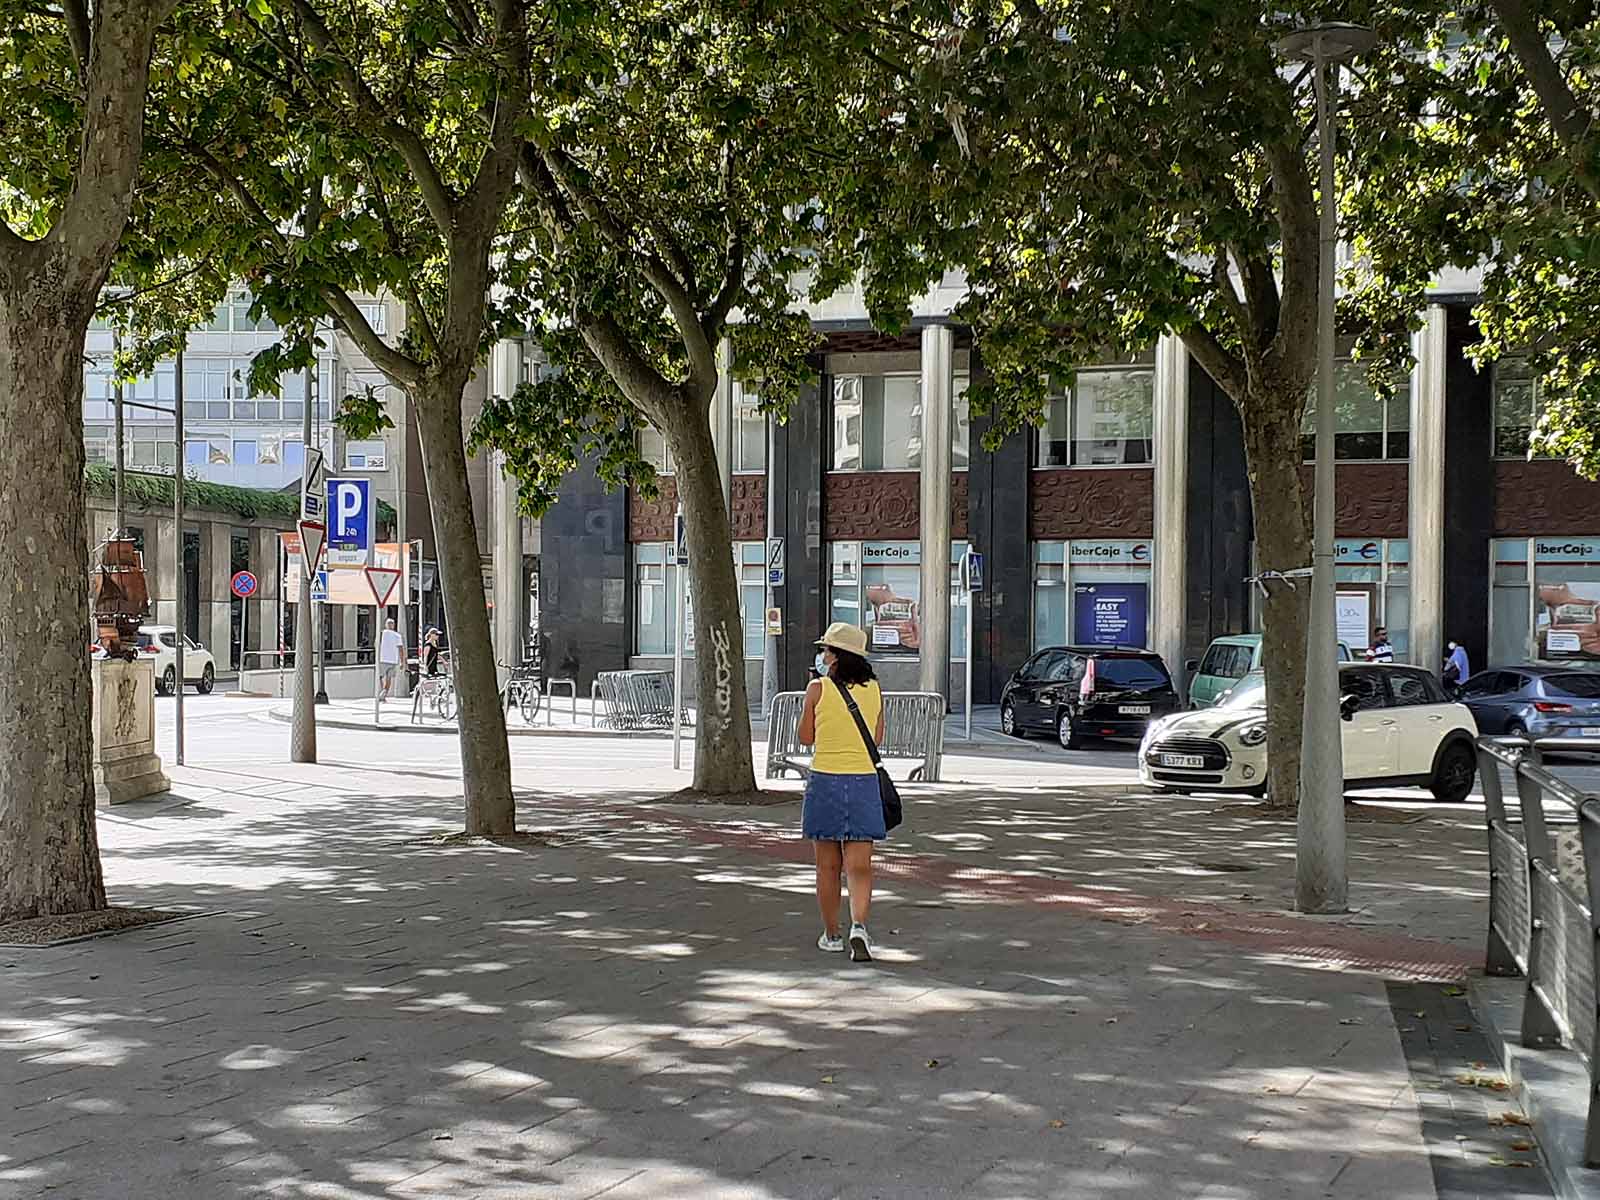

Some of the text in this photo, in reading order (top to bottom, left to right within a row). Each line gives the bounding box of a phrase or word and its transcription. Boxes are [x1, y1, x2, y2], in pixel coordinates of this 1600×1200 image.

[337, 483, 362, 536] P
[863, 546, 910, 559] iberCaja
[1071, 545, 1121, 558] iberCaja
[1536, 543, 1593, 556] iberCaja
[1096, 603, 1118, 611] EASY
